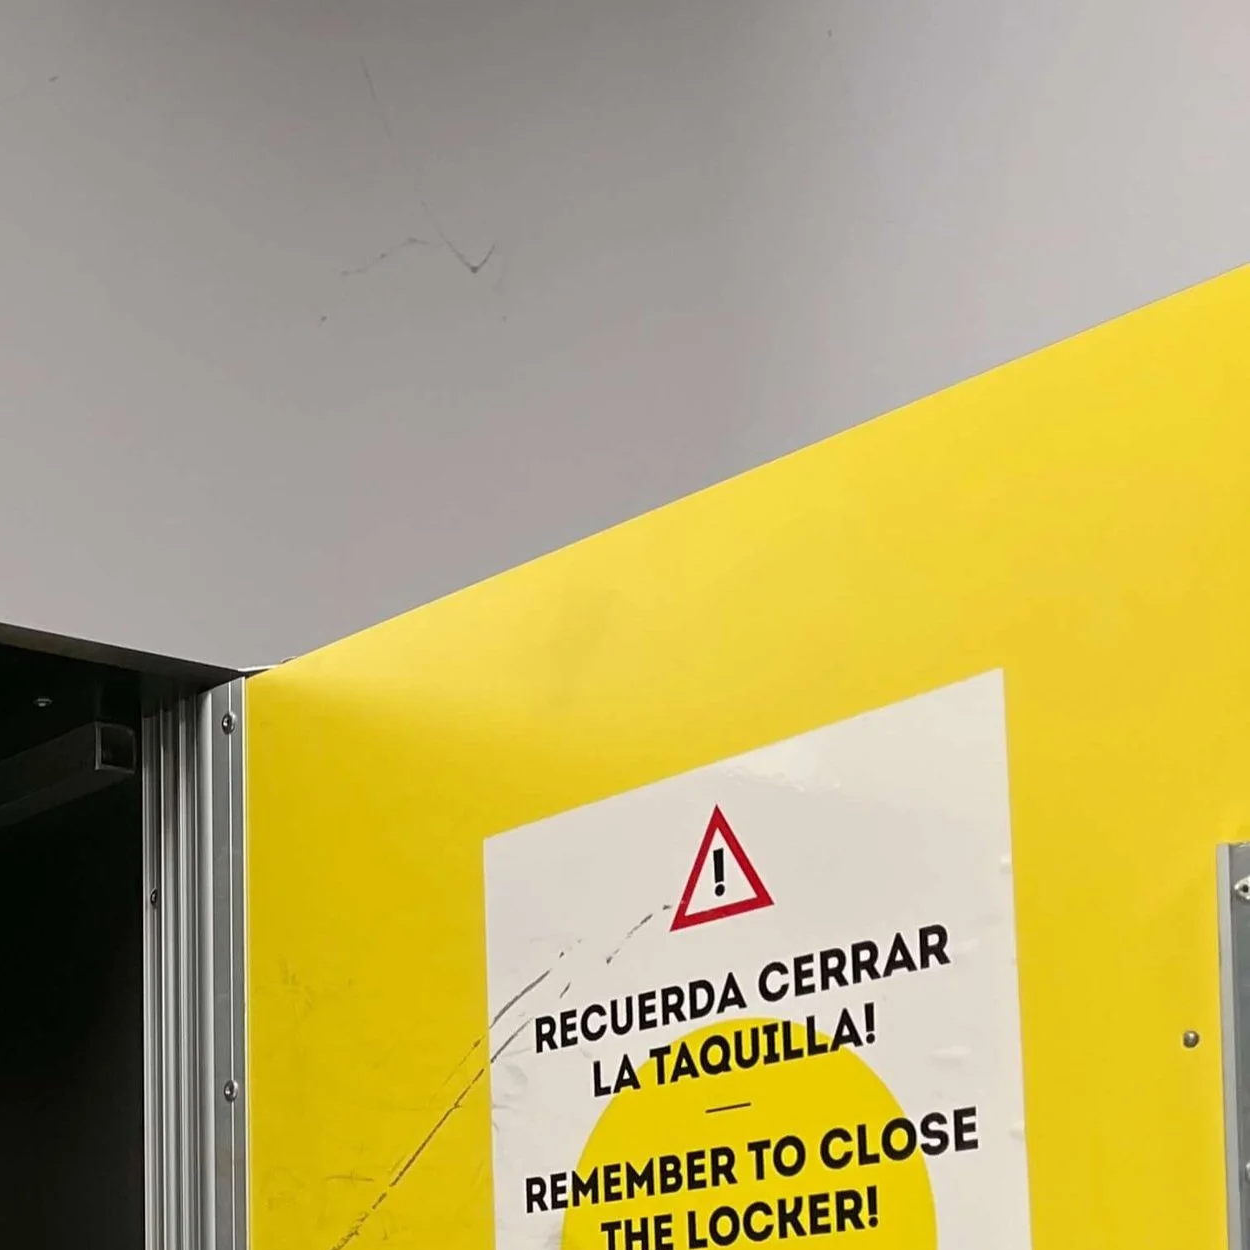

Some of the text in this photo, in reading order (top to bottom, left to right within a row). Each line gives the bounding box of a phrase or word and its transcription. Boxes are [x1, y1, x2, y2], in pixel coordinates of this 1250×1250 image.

[534, 924, 951, 1054] RECUERDA CERRAR
[592, 1002, 877, 1097] LA TAQUILLA!
[525, 1106, 979, 1214] REMEMBER TO CLOSE
[687, 1186, 879, 1250] LOCKER!
